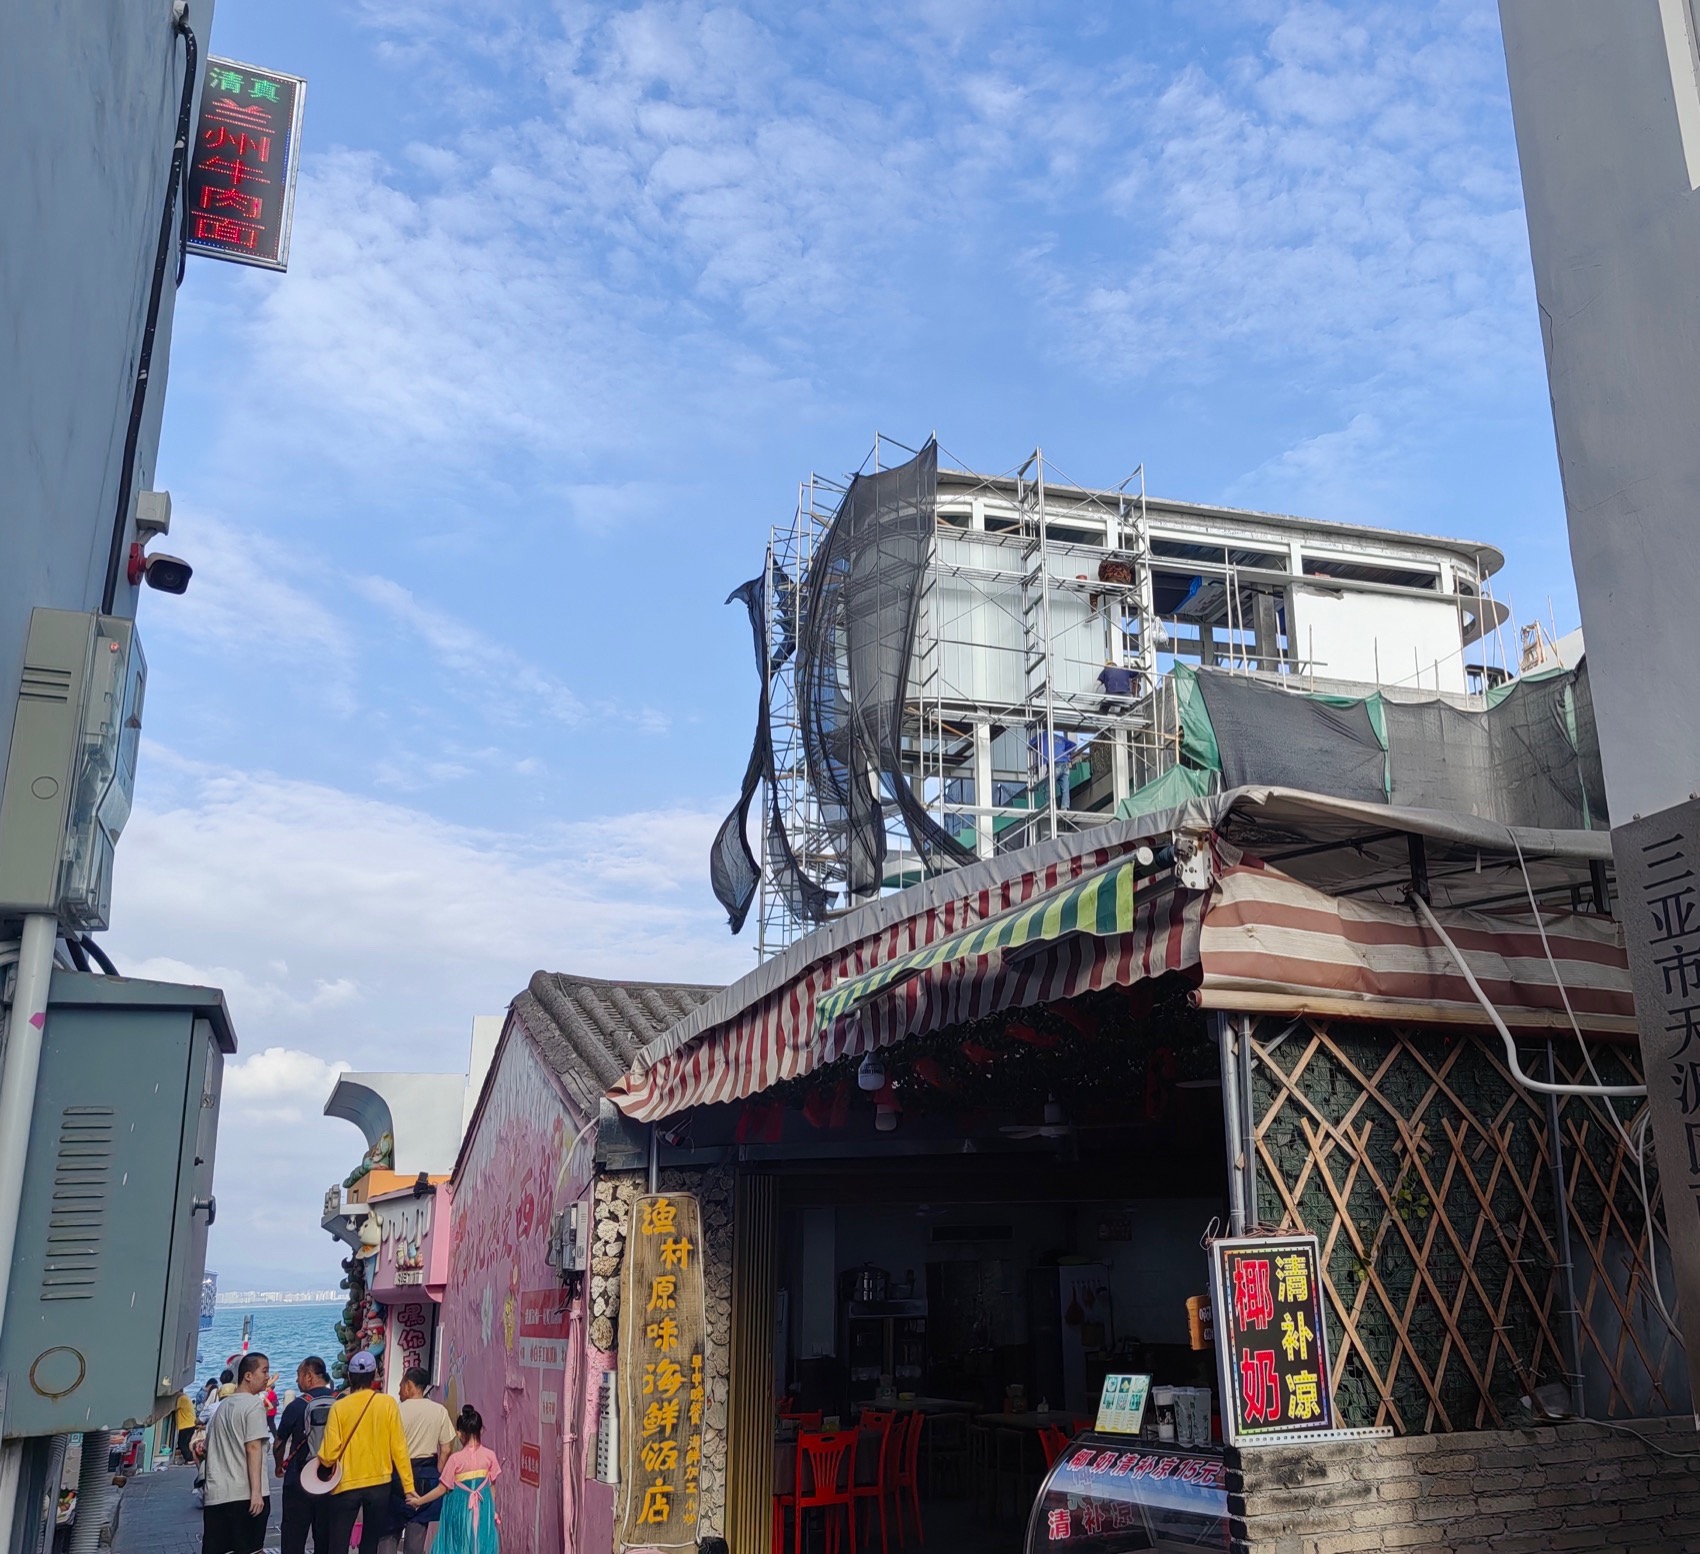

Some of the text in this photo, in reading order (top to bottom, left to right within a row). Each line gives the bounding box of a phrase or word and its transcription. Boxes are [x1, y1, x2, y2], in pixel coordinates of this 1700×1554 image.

[209, 67, 281, 104] 清真
[191, 97, 276, 249] 兰州牛肉面
[1640, 833, 1700, 1222] 三亚市天
[1233, 1257, 1281, 1424] 椰奶
[1275, 1254, 1321, 1420] 清补凉
[1047, 1501, 1134, 1540] 清补凉
